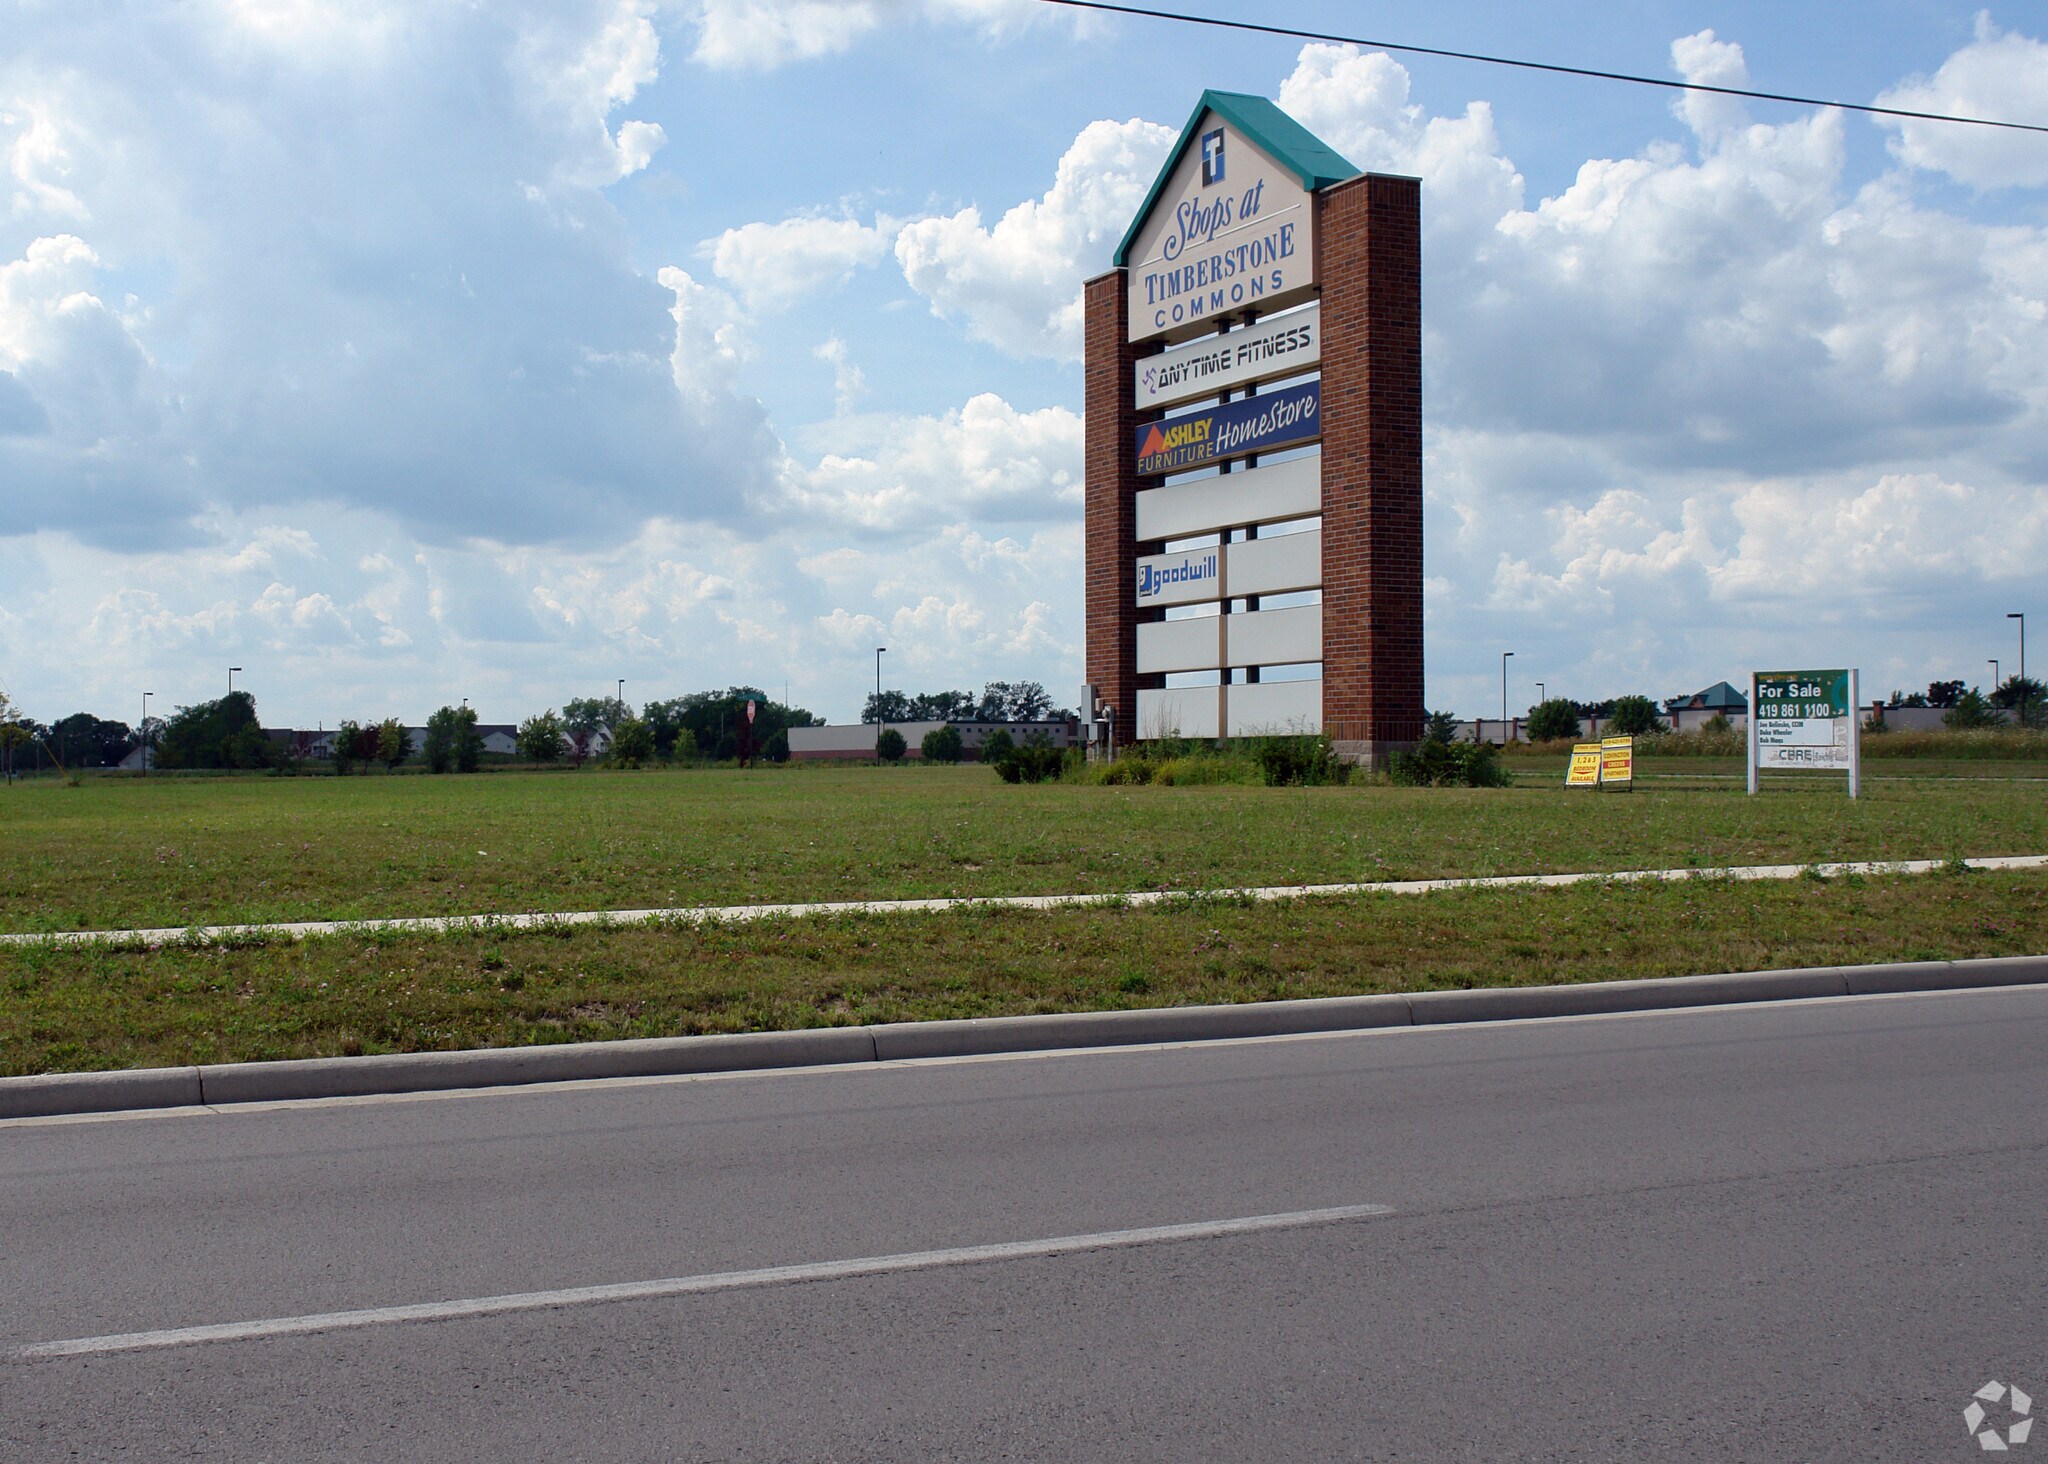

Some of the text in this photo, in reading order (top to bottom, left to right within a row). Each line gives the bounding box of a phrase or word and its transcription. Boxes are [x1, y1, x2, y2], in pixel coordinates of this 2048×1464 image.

[1163, 177, 1264, 261] Shops at
[1144, 222, 1295, 305] TIMBERSTONE
[1155, 269, 1283, 328] COMMONS
[1158, 325, 1312, 389] ANYTIME FITNESS
[1161, 417, 1213, 450] ASHLEY
[1137, 442, 1214, 474] FURNITURE
[1153, 555, 1217, 595] goodwill
[1758, 683, 1821, 698] For Sale
[1759, 703, 1830, 717] 419 861 1100
[1779, 749, 1812, 761] CBRE
